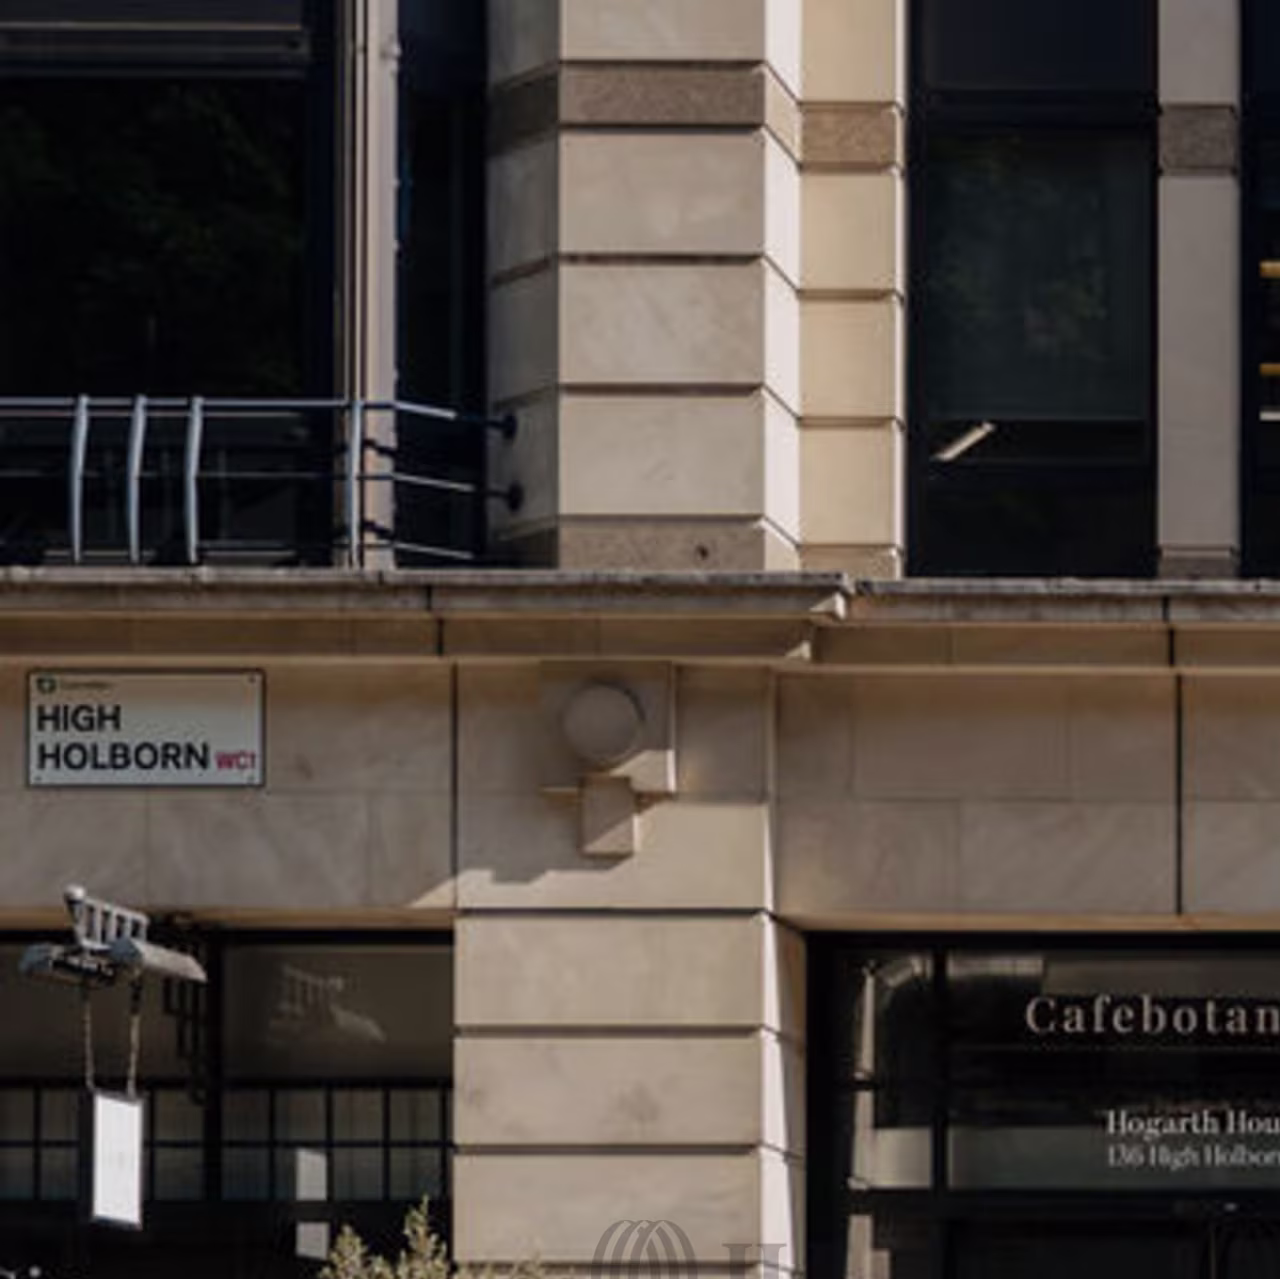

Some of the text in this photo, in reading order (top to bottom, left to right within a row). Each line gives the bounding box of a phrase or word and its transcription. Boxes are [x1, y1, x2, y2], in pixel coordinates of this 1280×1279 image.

[37, 705, 121, 731] HIGH
[37, 742, 256, 770] HOLBORN WC1
[1107, 1109, 1220, 1141] Hogarth
[1149, 1145, 1200, 1171] High
